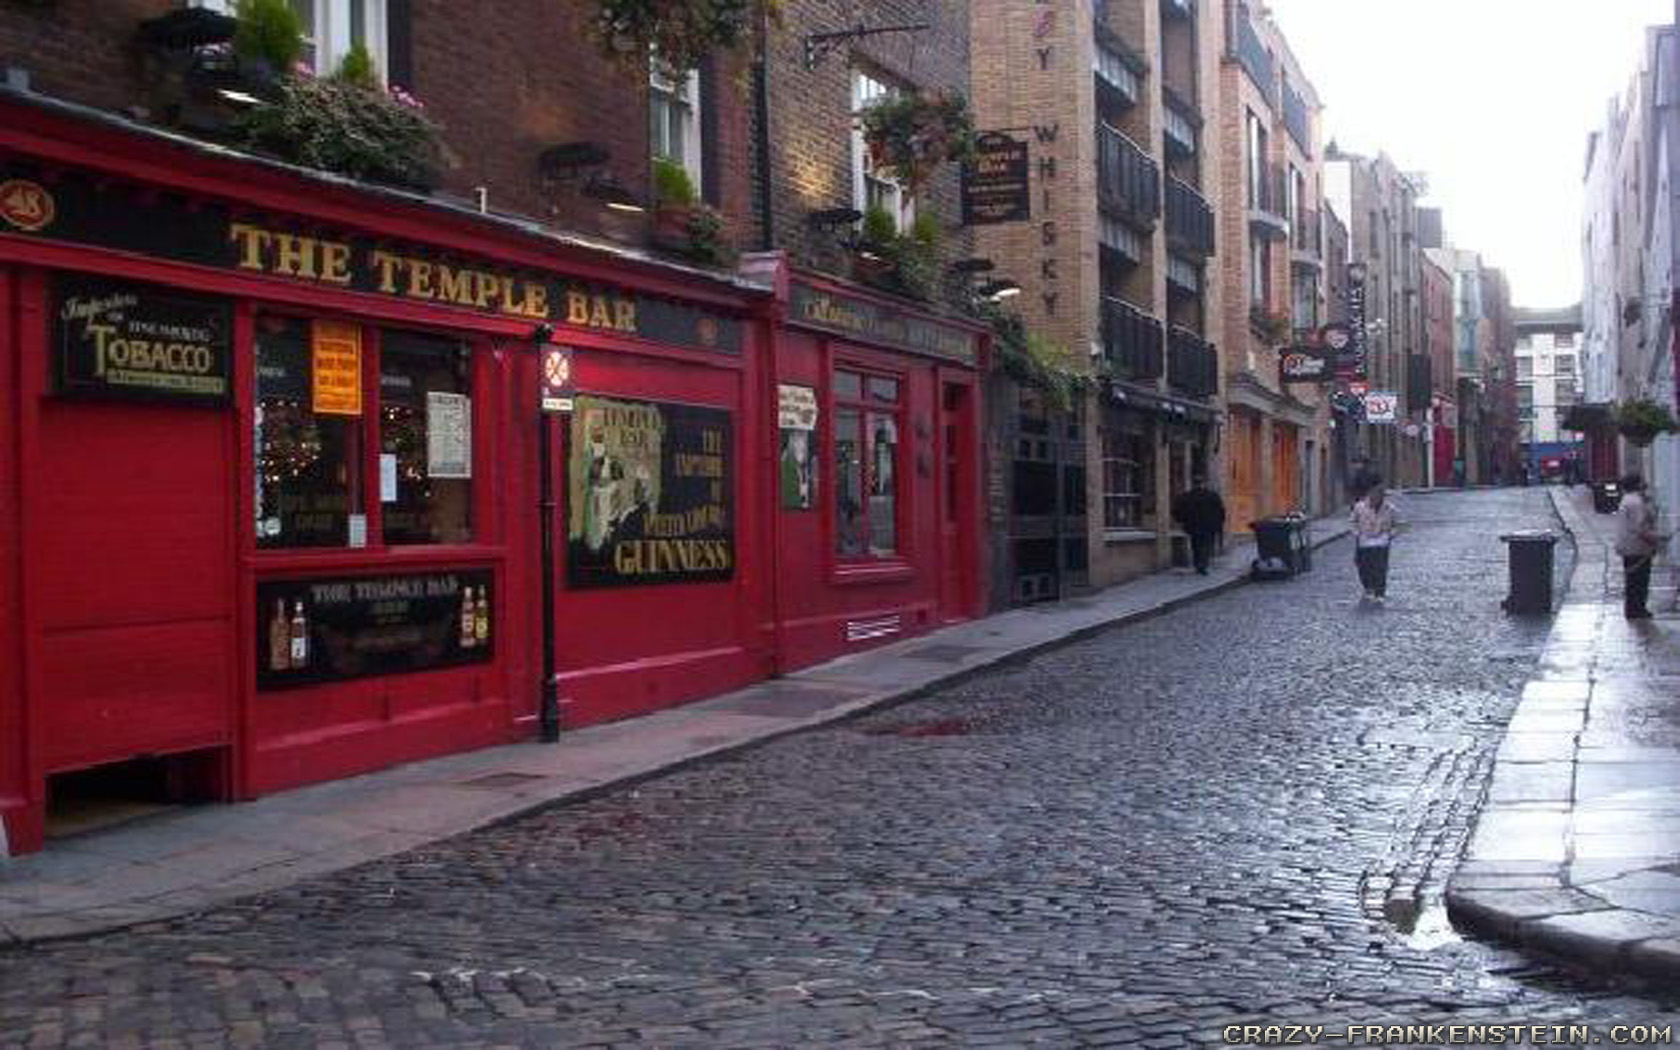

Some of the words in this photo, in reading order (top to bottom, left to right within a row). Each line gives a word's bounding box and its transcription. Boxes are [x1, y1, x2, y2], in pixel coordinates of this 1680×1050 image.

[231, 223, 352, 283] THE
[373, 250, 549, 318] TEMPLE
[566, 288, 638, 332] BAR
[86, 324, 211, 376] TOBACCO
[614, 538, 731, 575] GUINNESS
